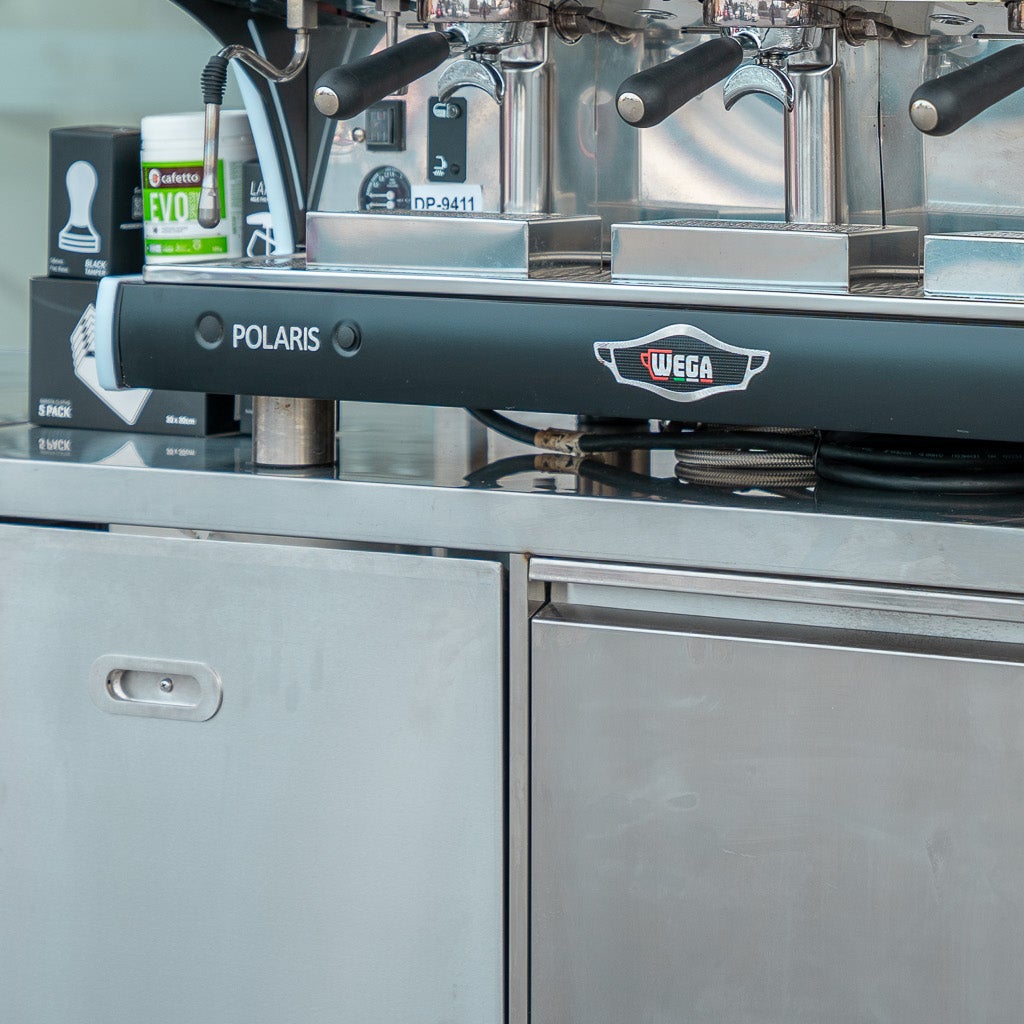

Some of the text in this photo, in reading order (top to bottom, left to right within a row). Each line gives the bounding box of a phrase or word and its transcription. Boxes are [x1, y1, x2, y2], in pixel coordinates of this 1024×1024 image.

[161, 171, 200, 185] cafetto
[149, 191, 189, 222] EVO
[414, 195, 475, 211] DP-9411
[85, 258, 107, 268] BLACK
[232, 323, 321, 352] POLARIS
[651, 352, 713, 379] WEGA
[38, 403, 72, 419] 5 PACK
